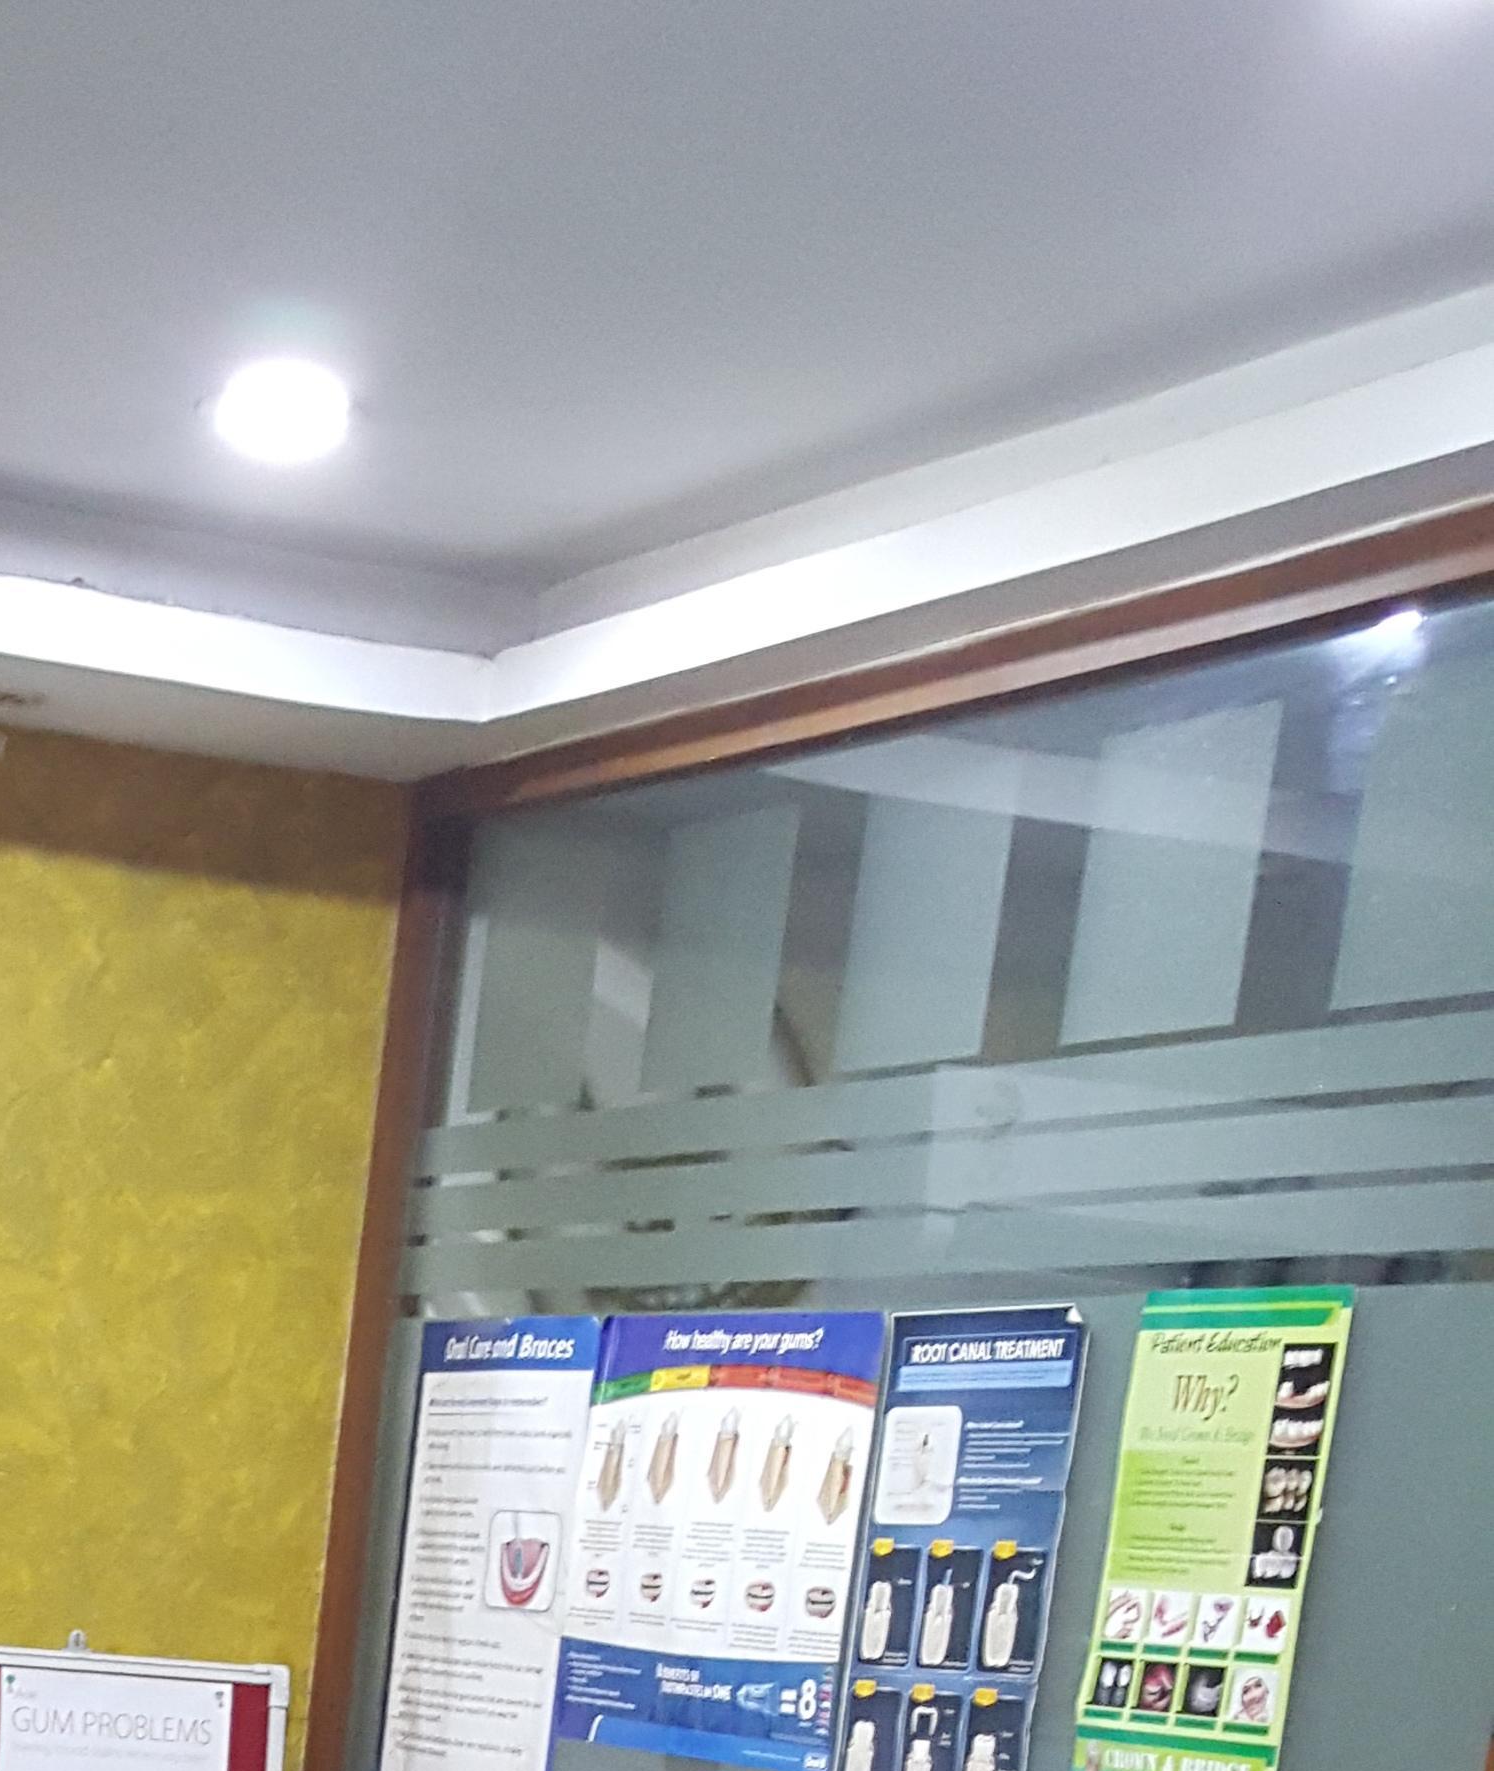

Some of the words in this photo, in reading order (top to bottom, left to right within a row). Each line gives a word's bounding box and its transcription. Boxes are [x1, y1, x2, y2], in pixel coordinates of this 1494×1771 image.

[517, 1334, 575, 1360] Braces
[663, 1330, 691, 1351] How
[692, 1328, 734, 1355] healthy
[733, 1334, 753, 1350] are
[749, 1333, 781, 1355] your
[777, 1327, 825, 1355] gums?
[910, 1344, 947, 1363] ROOT
[947, 1341, 993, 1362] CANAL
[993, 1338, 1066, 1360] TREATMENT
[1152, 1332, 1205, 1354] Patient
[1206, 1331, 1283, 1354] Education
[1173, 1374, 1240, 1421] Why?
[11, 1706, 74, 1736] GUM
[82, 1711, 212, 1746] PROBLEMS
